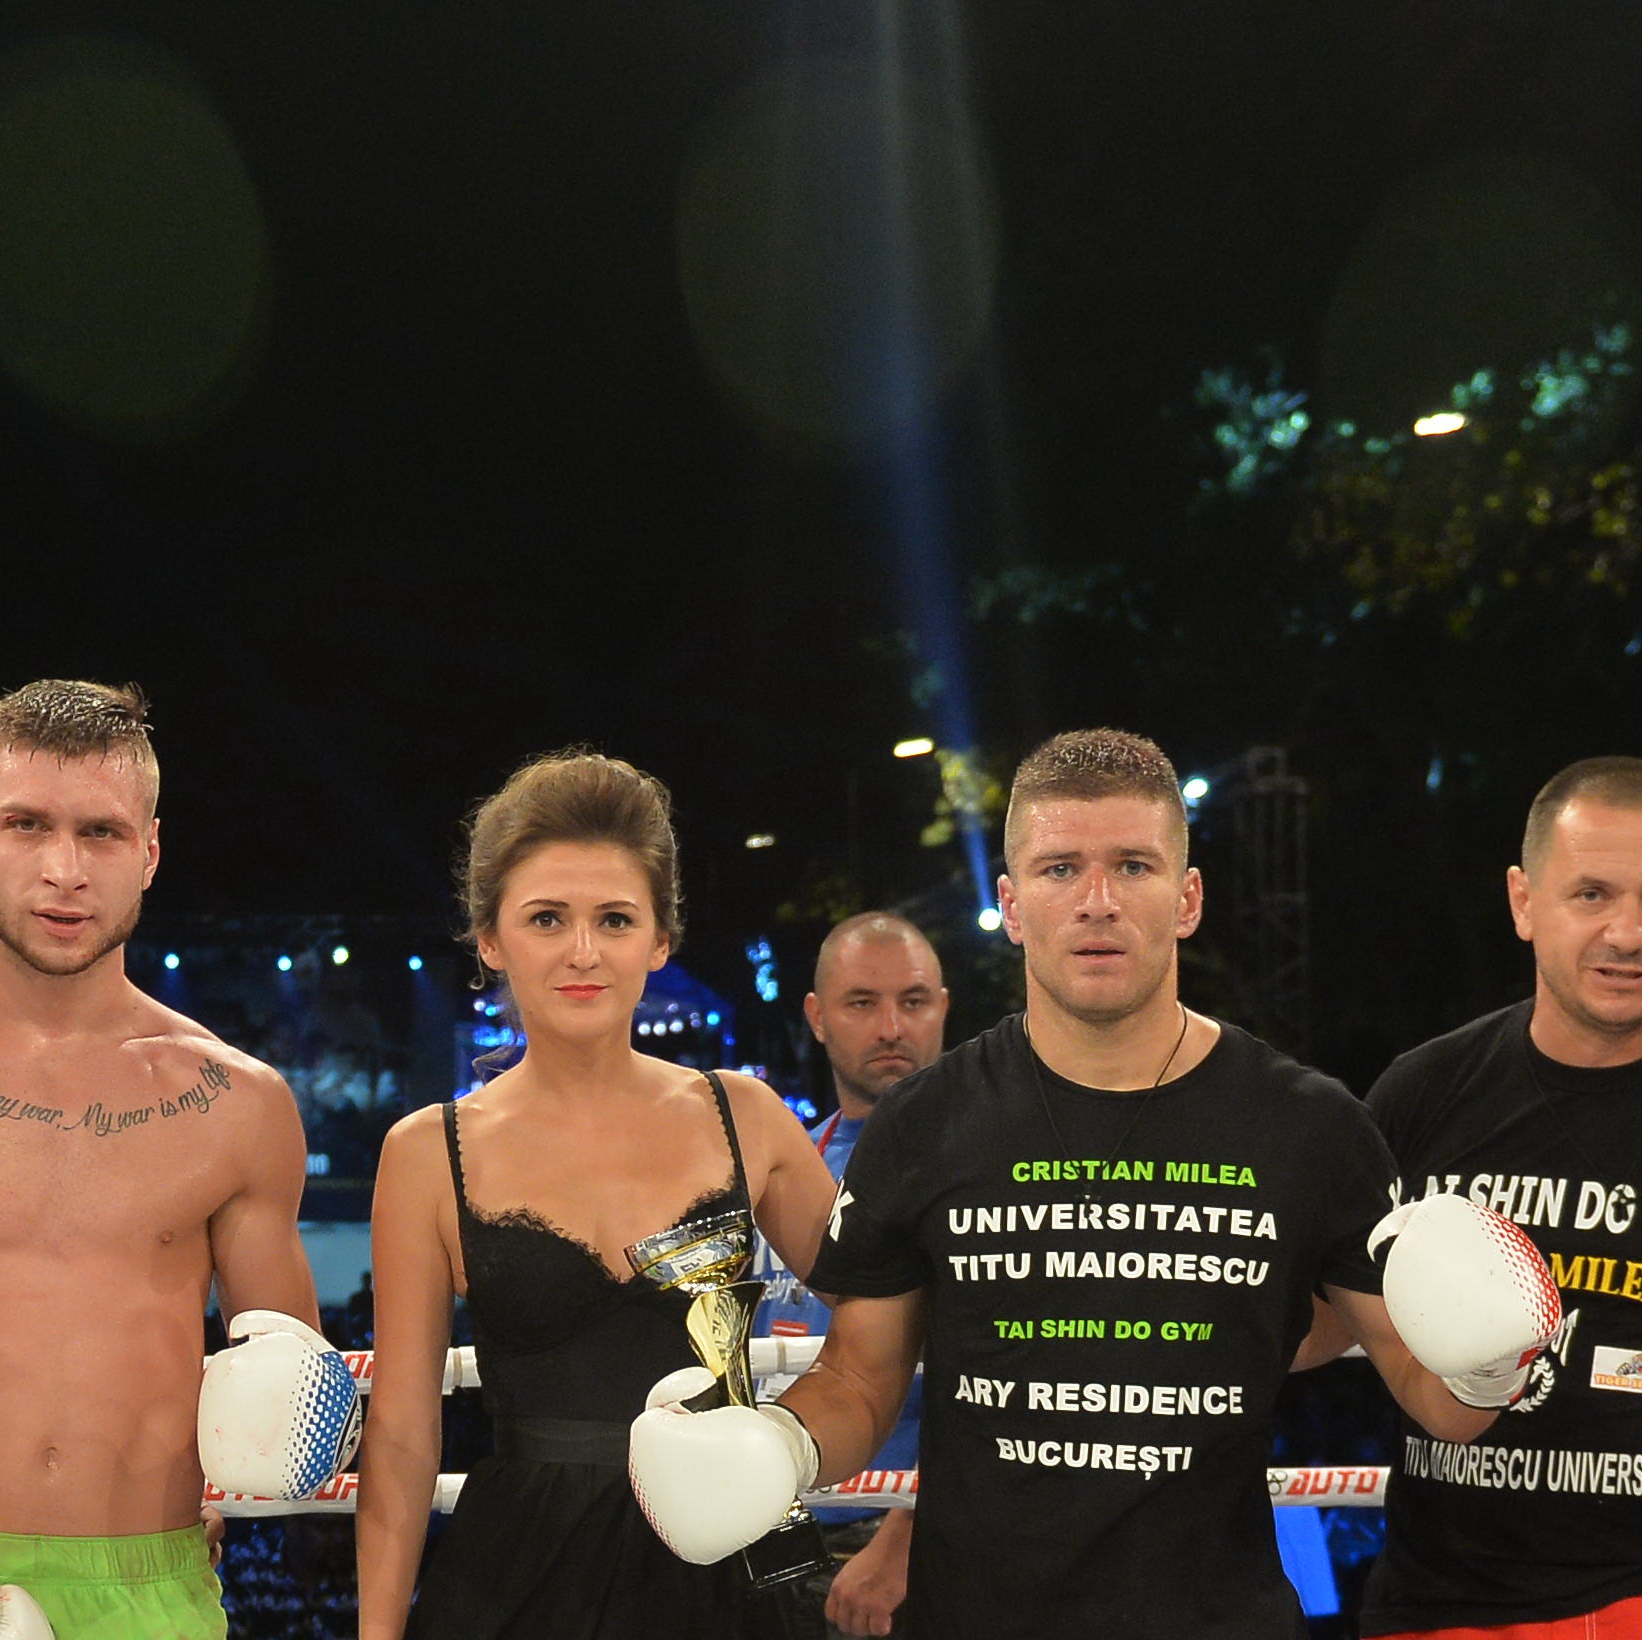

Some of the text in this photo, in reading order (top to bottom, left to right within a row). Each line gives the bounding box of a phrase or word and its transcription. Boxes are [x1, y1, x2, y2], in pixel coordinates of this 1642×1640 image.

[61, 1103, 120, 1137] My
[161, 1098, 178, 1118] is
[179, 1088, 219, 1114] my
[199, 1058, 231, 1091] life
[1012, 1160, 1256, 1188] CRISTIAN MILEA
[1469, 1174, 1567, 1228] SHIN
[949, 1203, 1278, 1241] UNIVERSITATEA
[949, 1251, 1269, 1287] TITU MAIORESCU
[994, 1319, 1213, 1341] TAI SHIN DO GYM
[1028, 1381, 1243, 1415] RESIDENCE
[1405, 1436, 1429, 1478] TITU
[1430, 1440, 1541, 1491] MAIORESCU
[1286, 1470, 1380, 1496] AUTO
